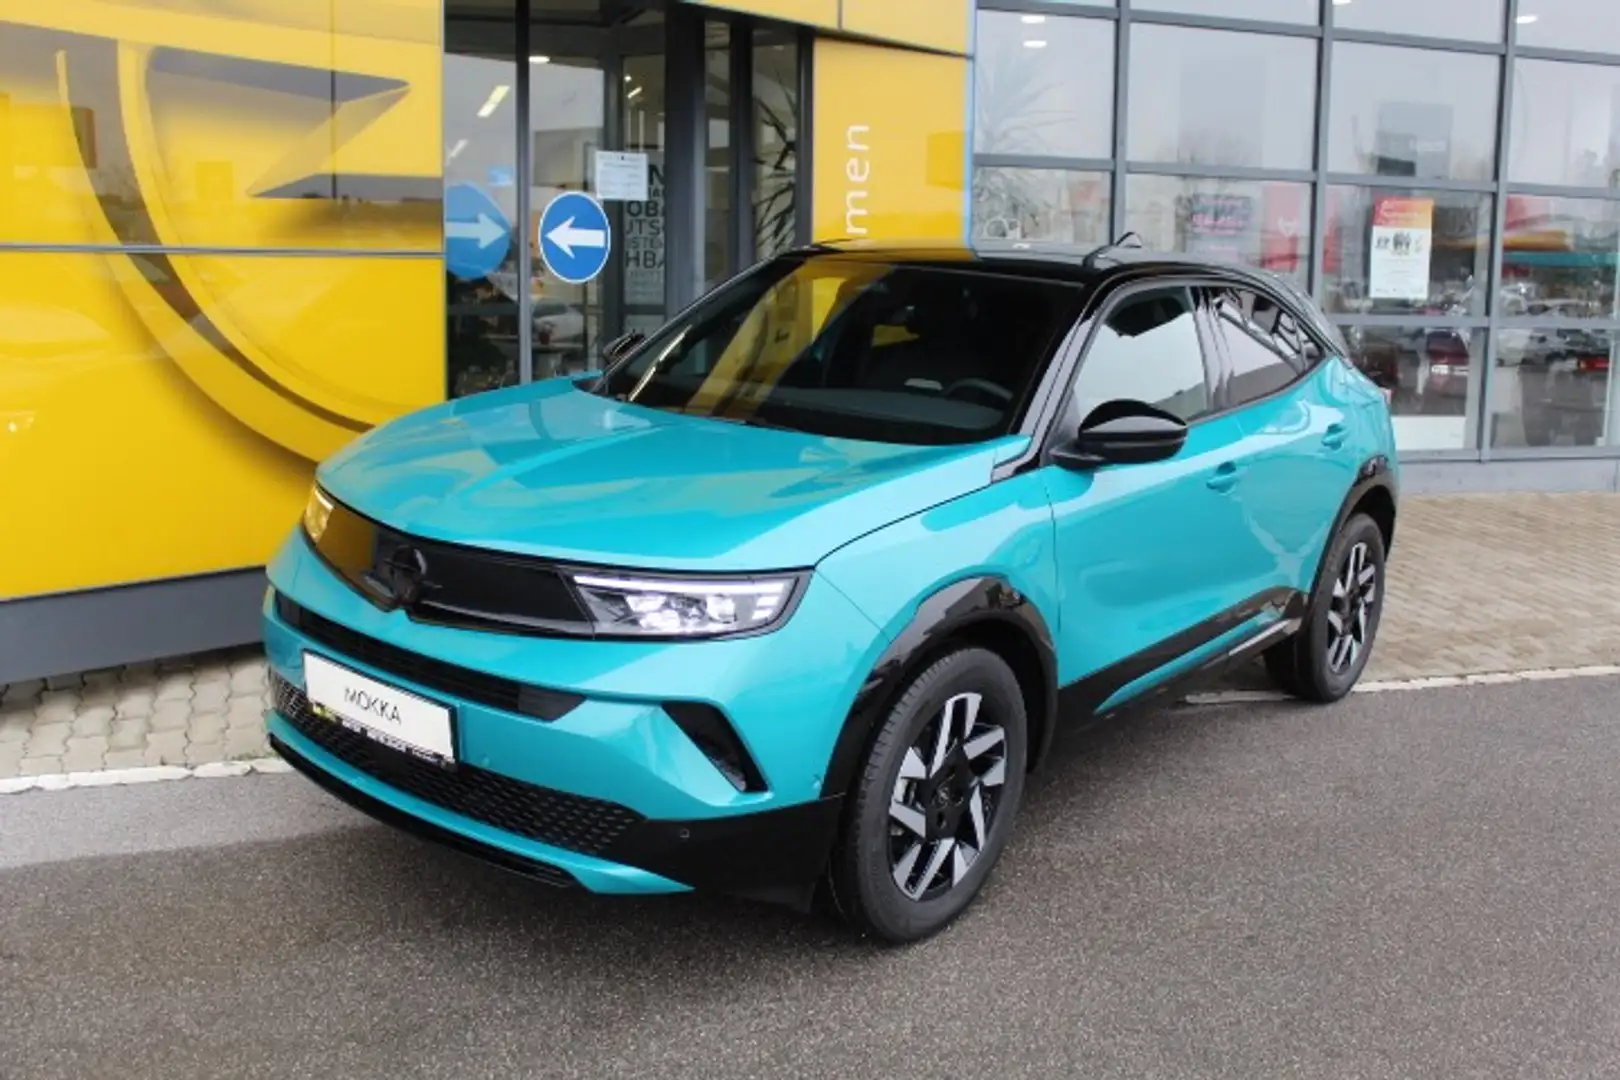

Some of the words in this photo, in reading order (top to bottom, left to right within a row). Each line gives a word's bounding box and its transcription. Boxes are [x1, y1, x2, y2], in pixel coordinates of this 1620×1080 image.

[846, 125, 870, 235] men
[627, 201, 664, 217] OB
[344, 686, 403, 726] MOKKA
